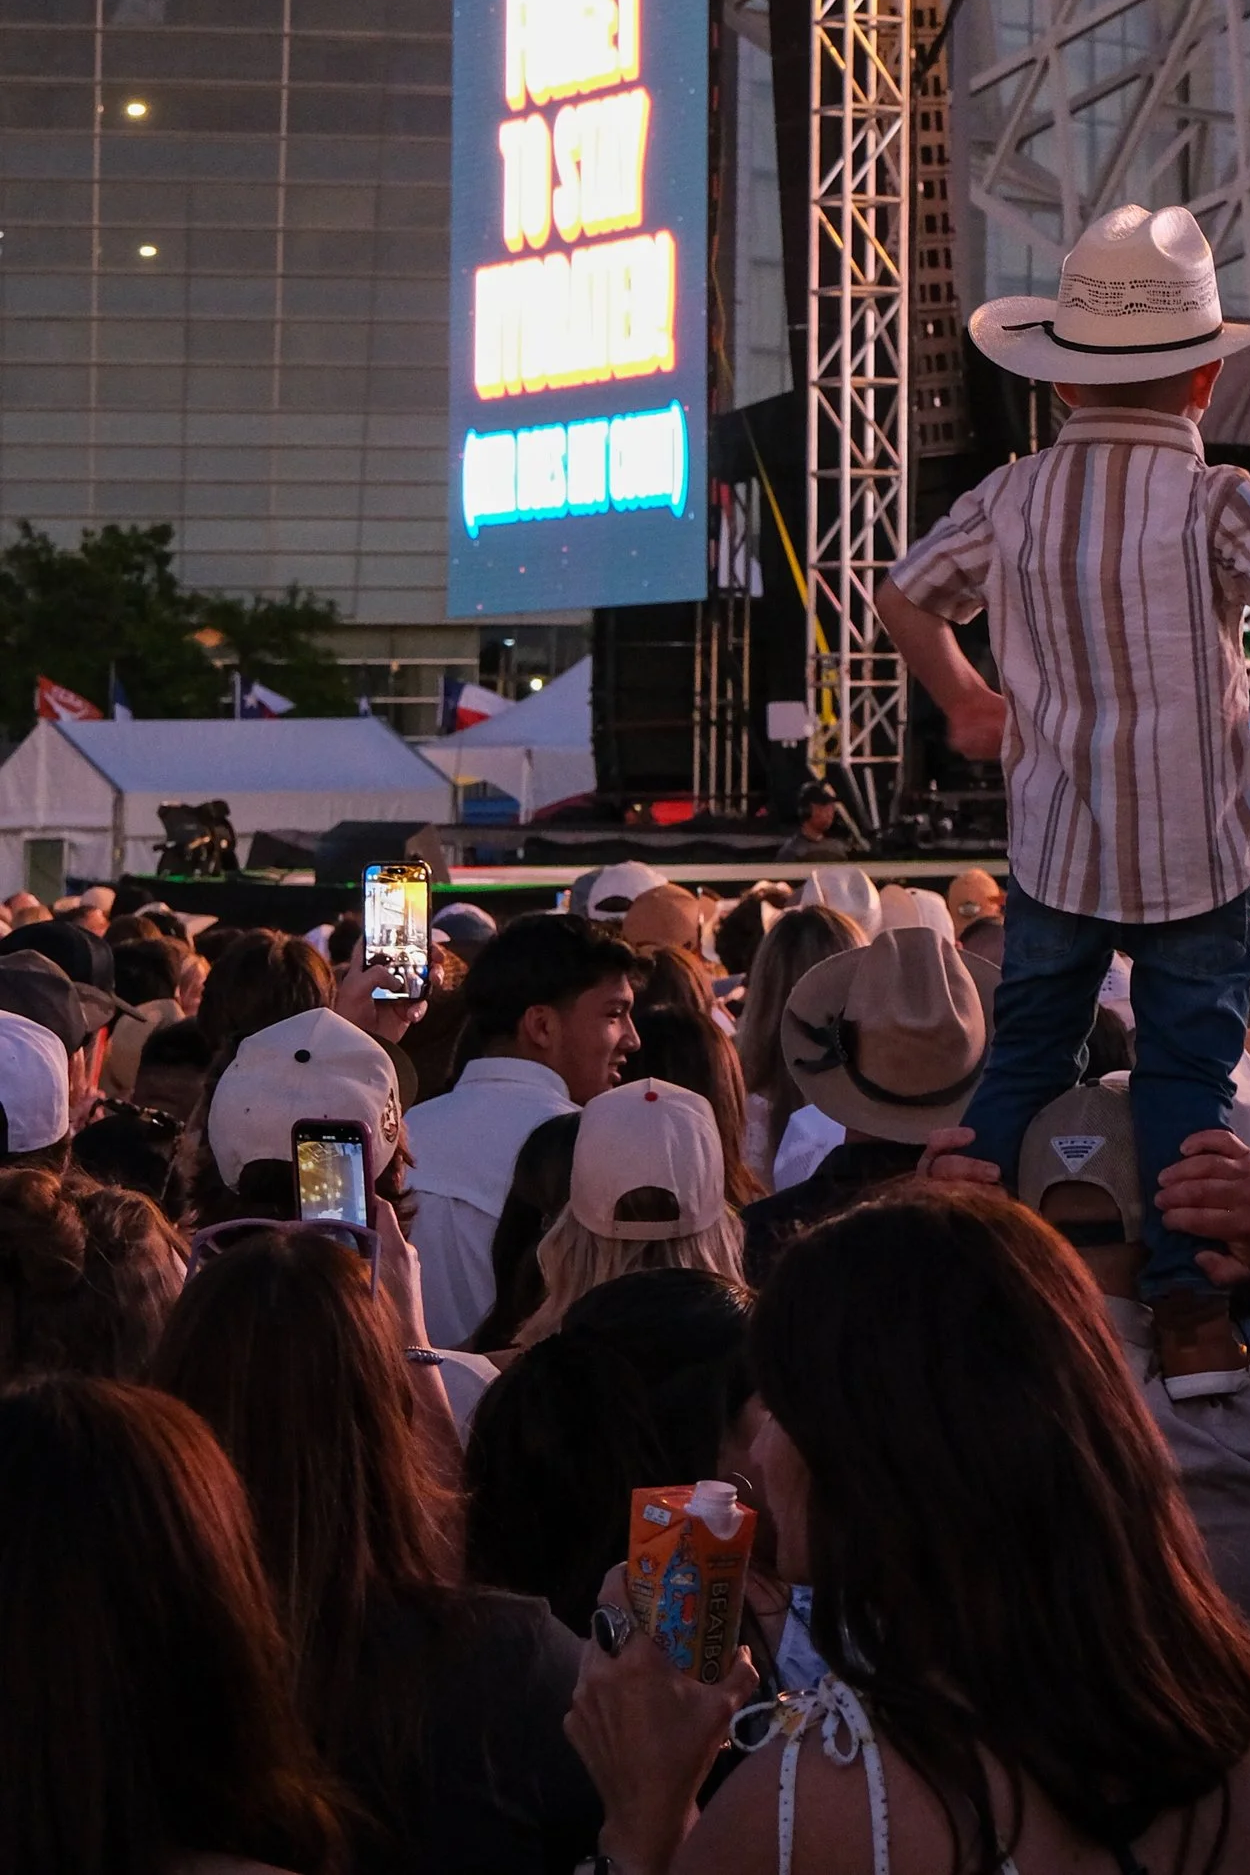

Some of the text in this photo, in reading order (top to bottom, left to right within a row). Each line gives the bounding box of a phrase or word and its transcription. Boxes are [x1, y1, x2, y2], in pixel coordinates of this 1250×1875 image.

[499, 85, 652, 254] TO STAY
[701, 1581, 729, 1685] BEATBO
